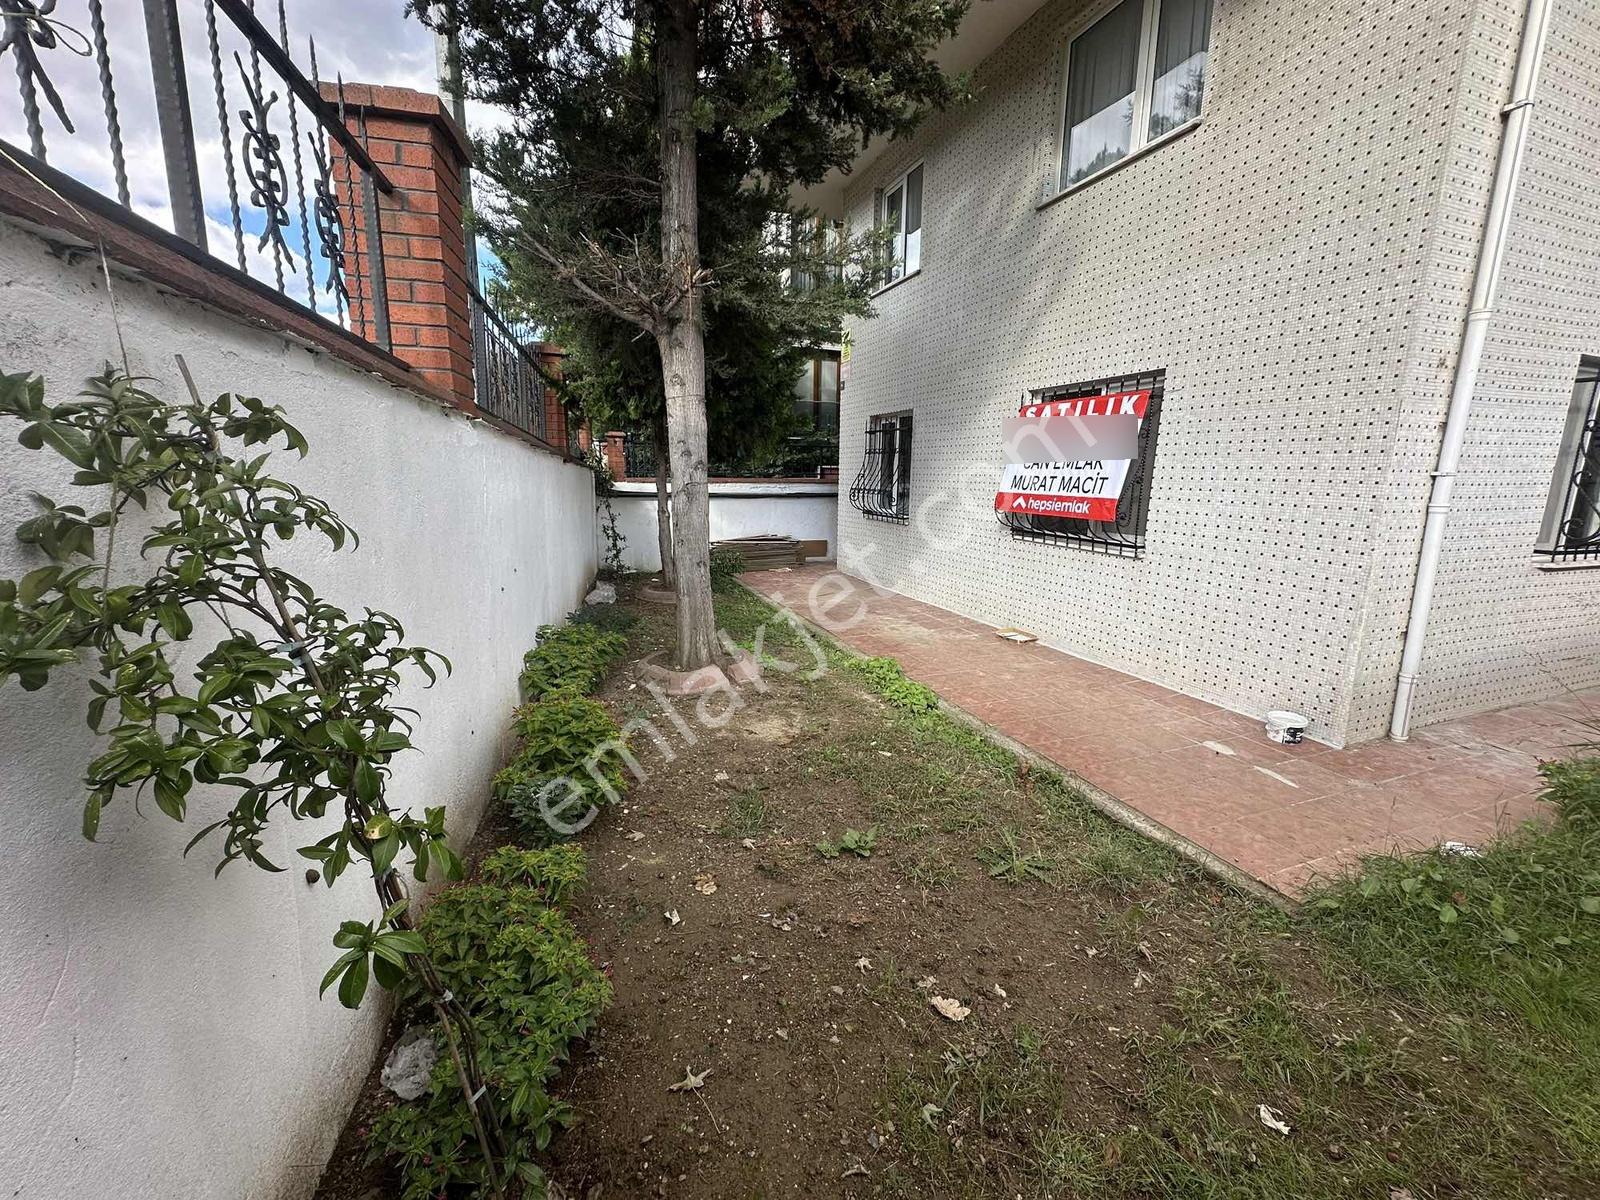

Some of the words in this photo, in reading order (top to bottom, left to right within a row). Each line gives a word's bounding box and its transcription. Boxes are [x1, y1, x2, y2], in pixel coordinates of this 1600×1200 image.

[1025, 394, 1141, 417] SATILIK
[1010, 475, 1057, 492] MURAT
[1058, 472, 1109, 495] MACİT
